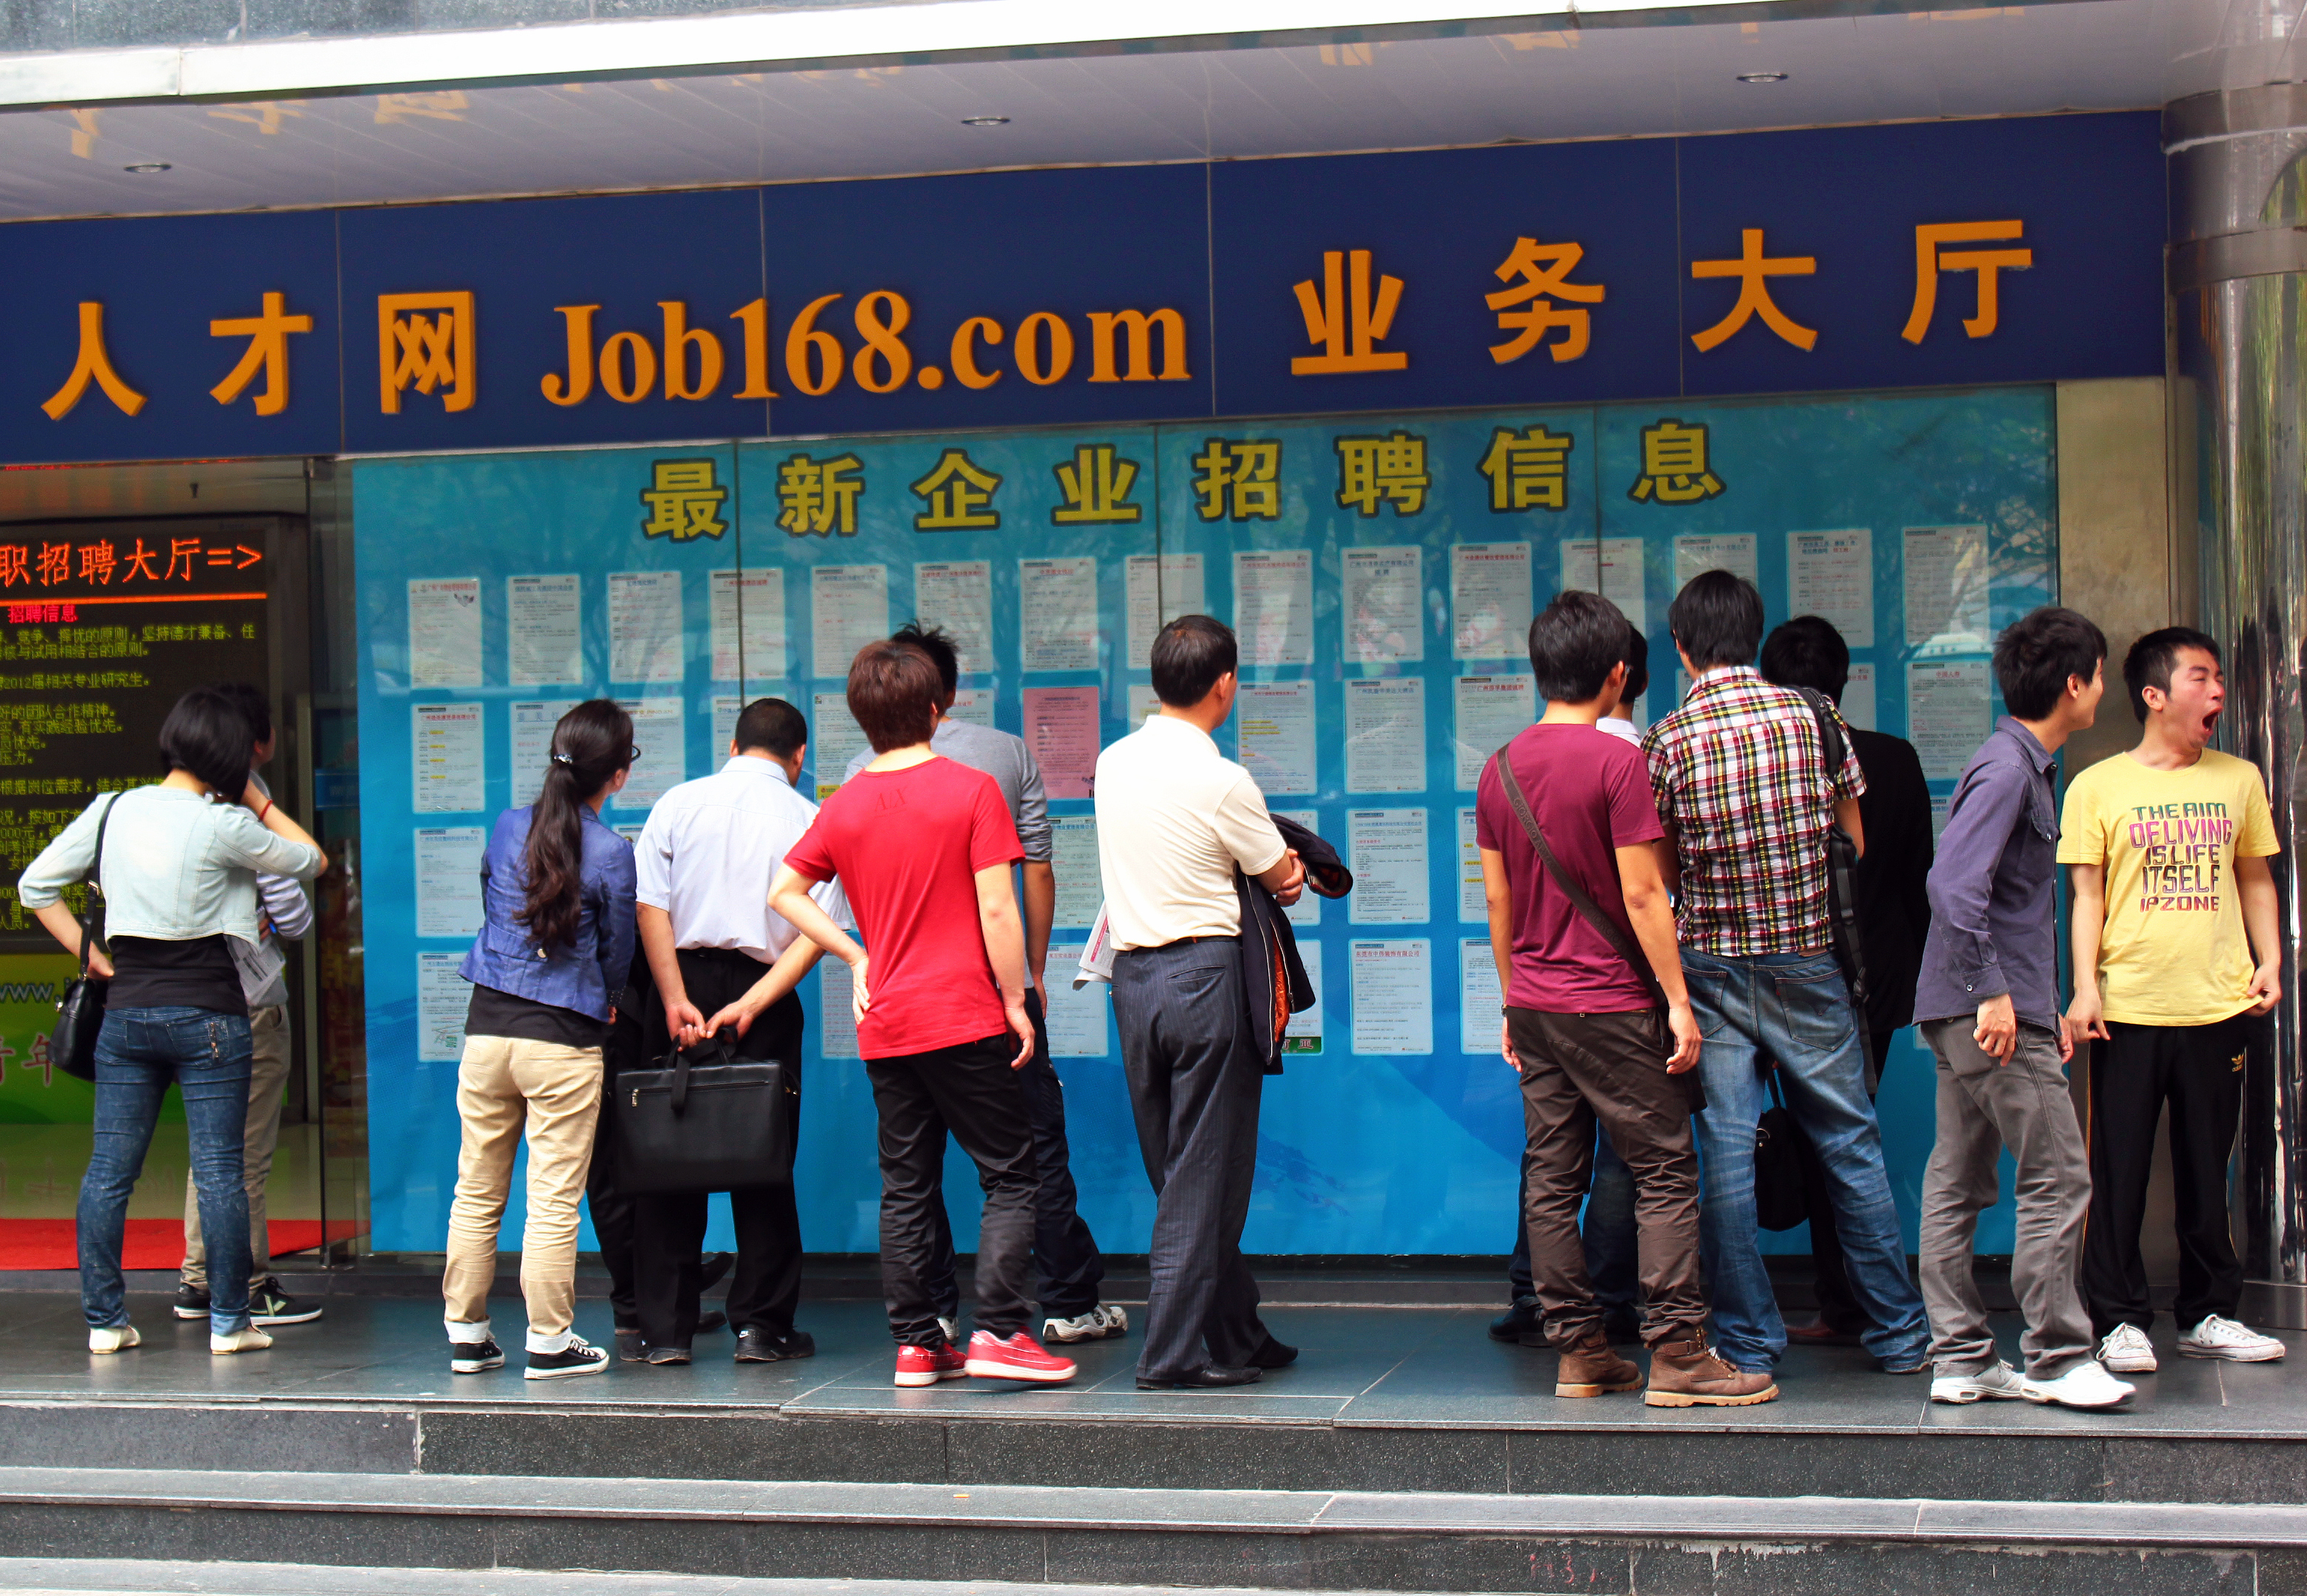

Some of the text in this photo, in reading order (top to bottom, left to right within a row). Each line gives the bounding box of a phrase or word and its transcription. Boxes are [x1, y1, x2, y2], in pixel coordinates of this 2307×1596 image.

[41, 220, 2033, 421] 人才网 Job168.com 业务大厅
[641, 419, 1726, 542] 最新企业招聘信息
[8, 604, 78, 624] 招聘信息
[0, 641, 150, 660] 核与试用相结合的原则。
[0, 671, 149, 690] 2012届相关专业研究生。
[2131, 803, 2227, 821] THE AIM
[2129, 818, 2233, 848] OF LIVING
[2145, 843, 2221, 865] IS LIFE
[2142, 865, 2221, 895] ITSELF
[2139, 896, 2220, 913] IPZONE
